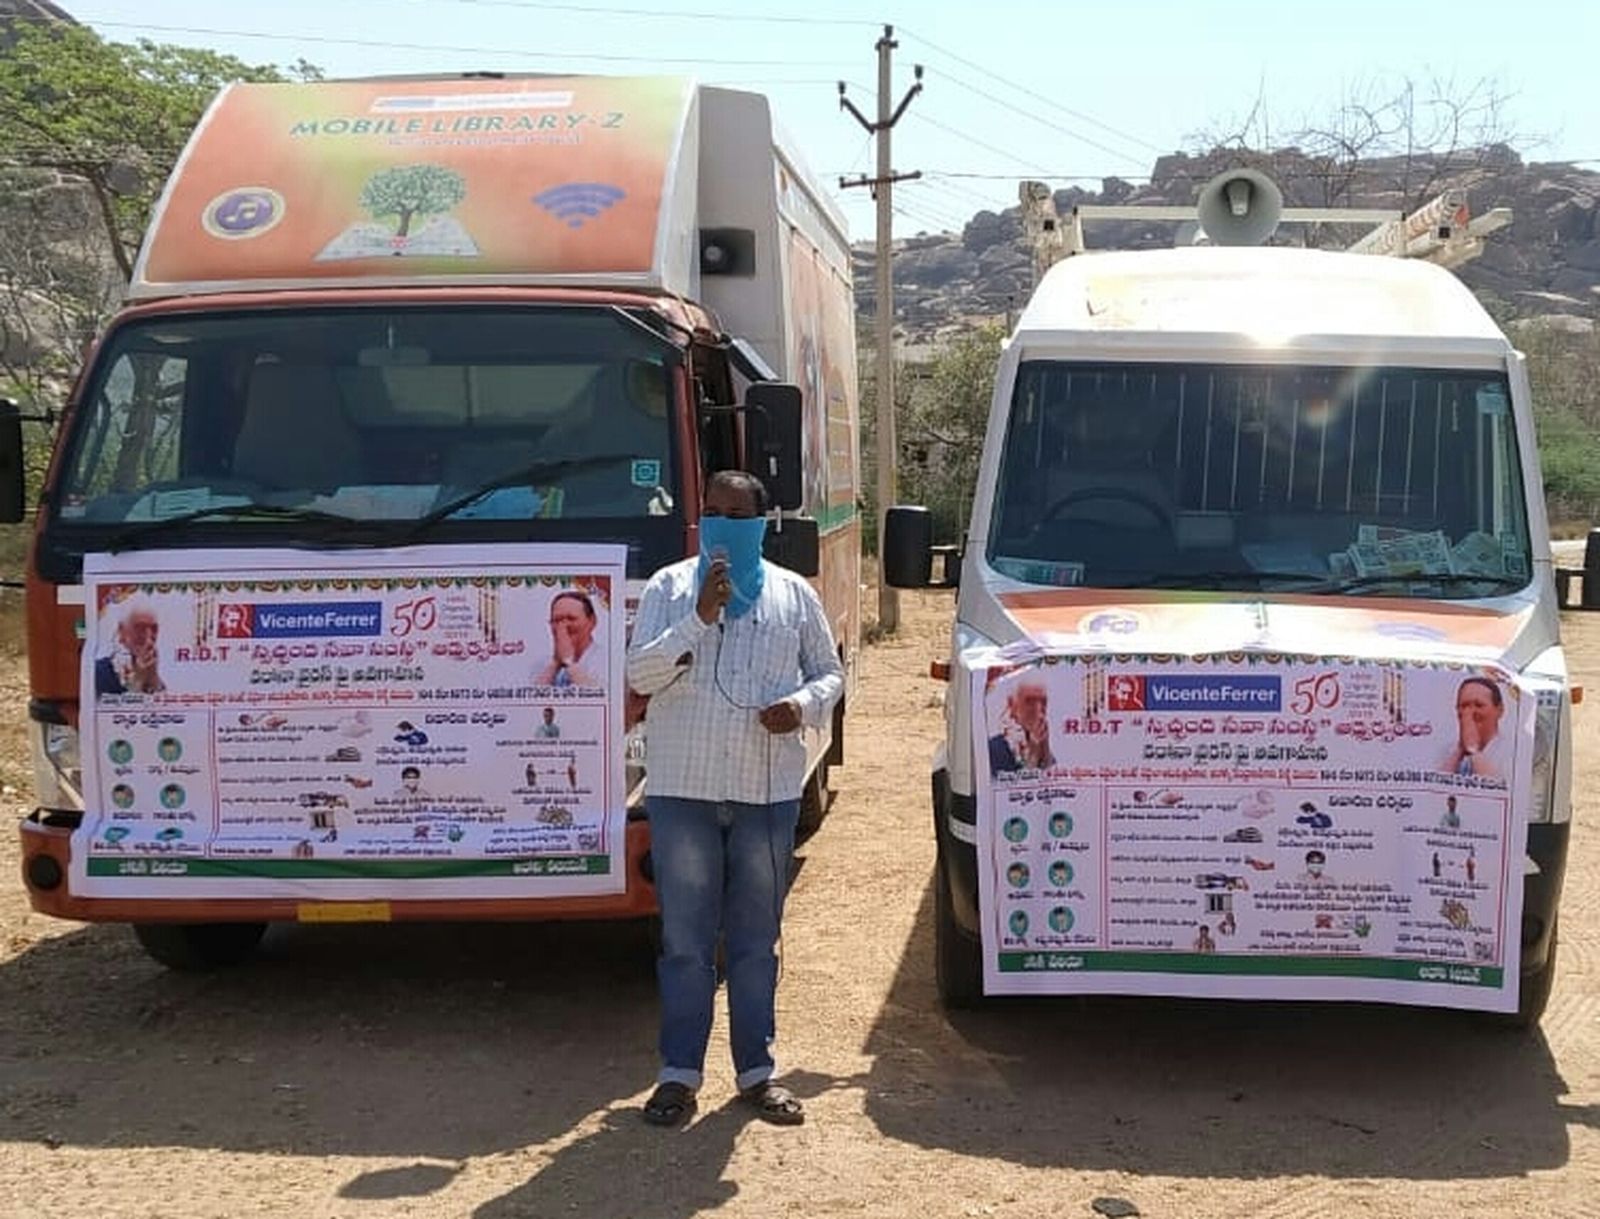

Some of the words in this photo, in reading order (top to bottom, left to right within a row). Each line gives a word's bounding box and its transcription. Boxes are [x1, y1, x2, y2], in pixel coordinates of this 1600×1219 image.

[290, 117, 422, 136] MOBILE
[259, 611, 377, 629] VicenteFerrer
[391, 596, 436, 637] 50
[177, 645, 230, 662] R.D.T
[1151, 685, 1279, 702] VicenteFerrer
[1290, 671, 1339, 716] 50
[1064, 719, 1123, 735] R.D.T
